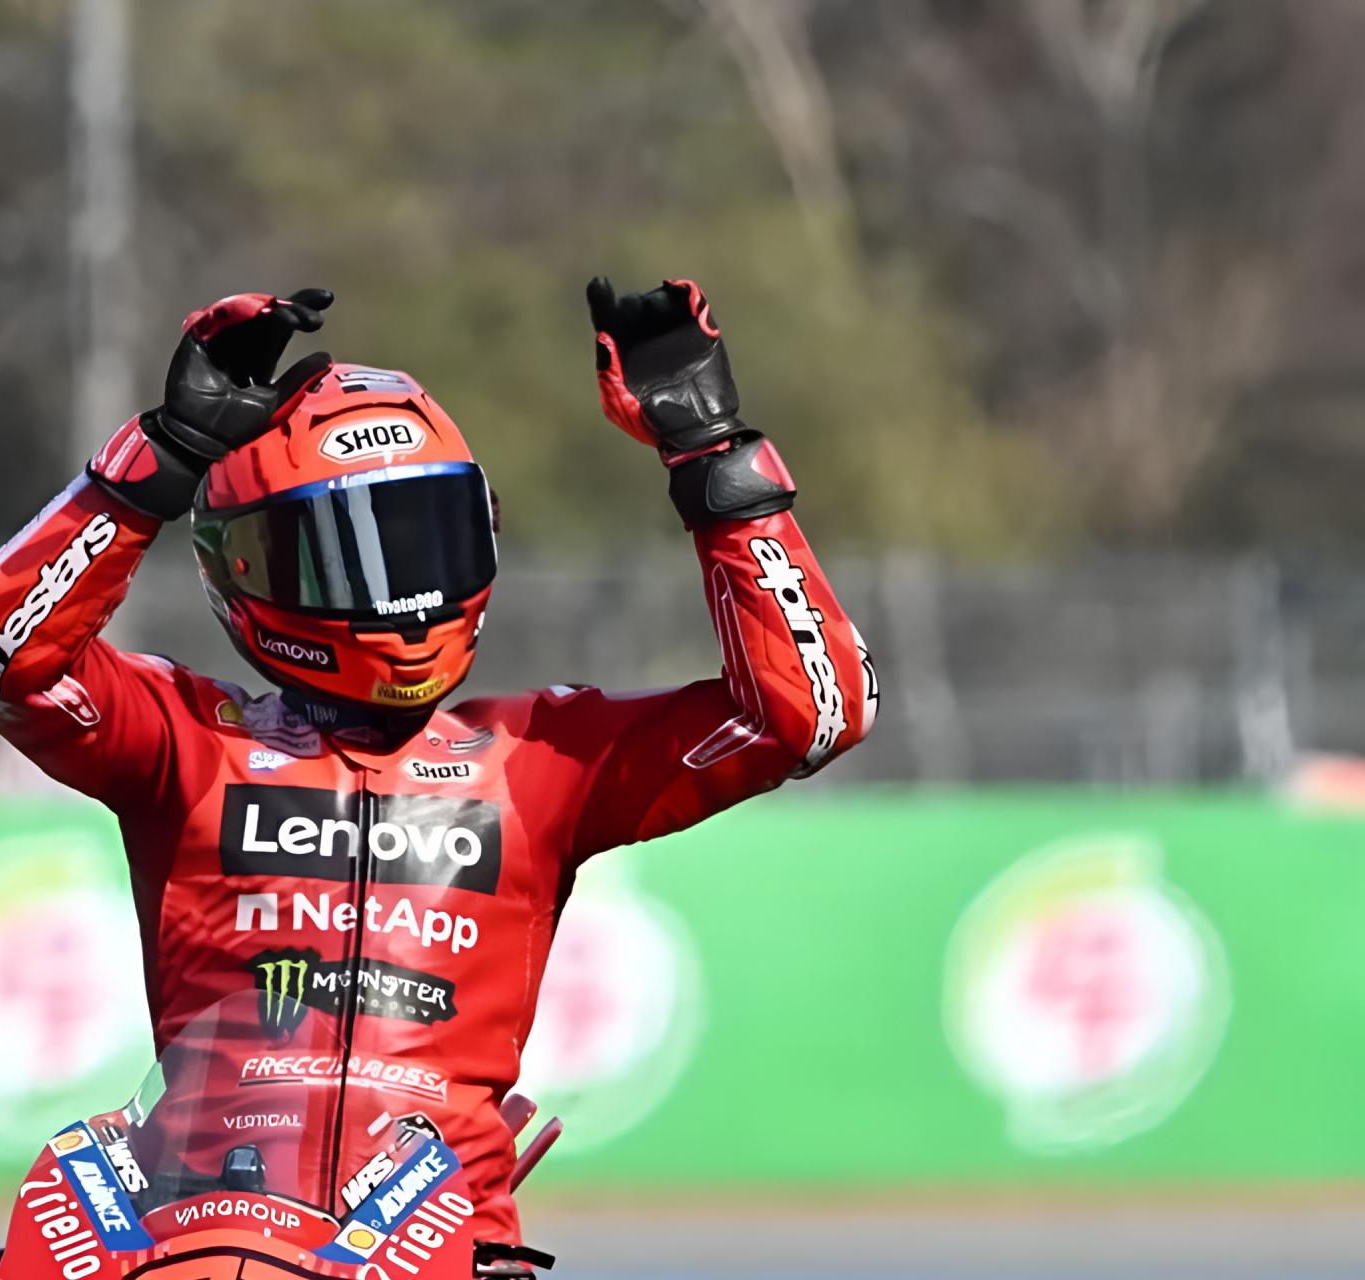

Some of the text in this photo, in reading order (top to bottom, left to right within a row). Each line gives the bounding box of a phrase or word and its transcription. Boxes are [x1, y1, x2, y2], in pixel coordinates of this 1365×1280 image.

[749, 537, 848, 764] alpinesta
[242, 803, 482, 867] Lenovo
[293, 893, 479, 954] NetApp
